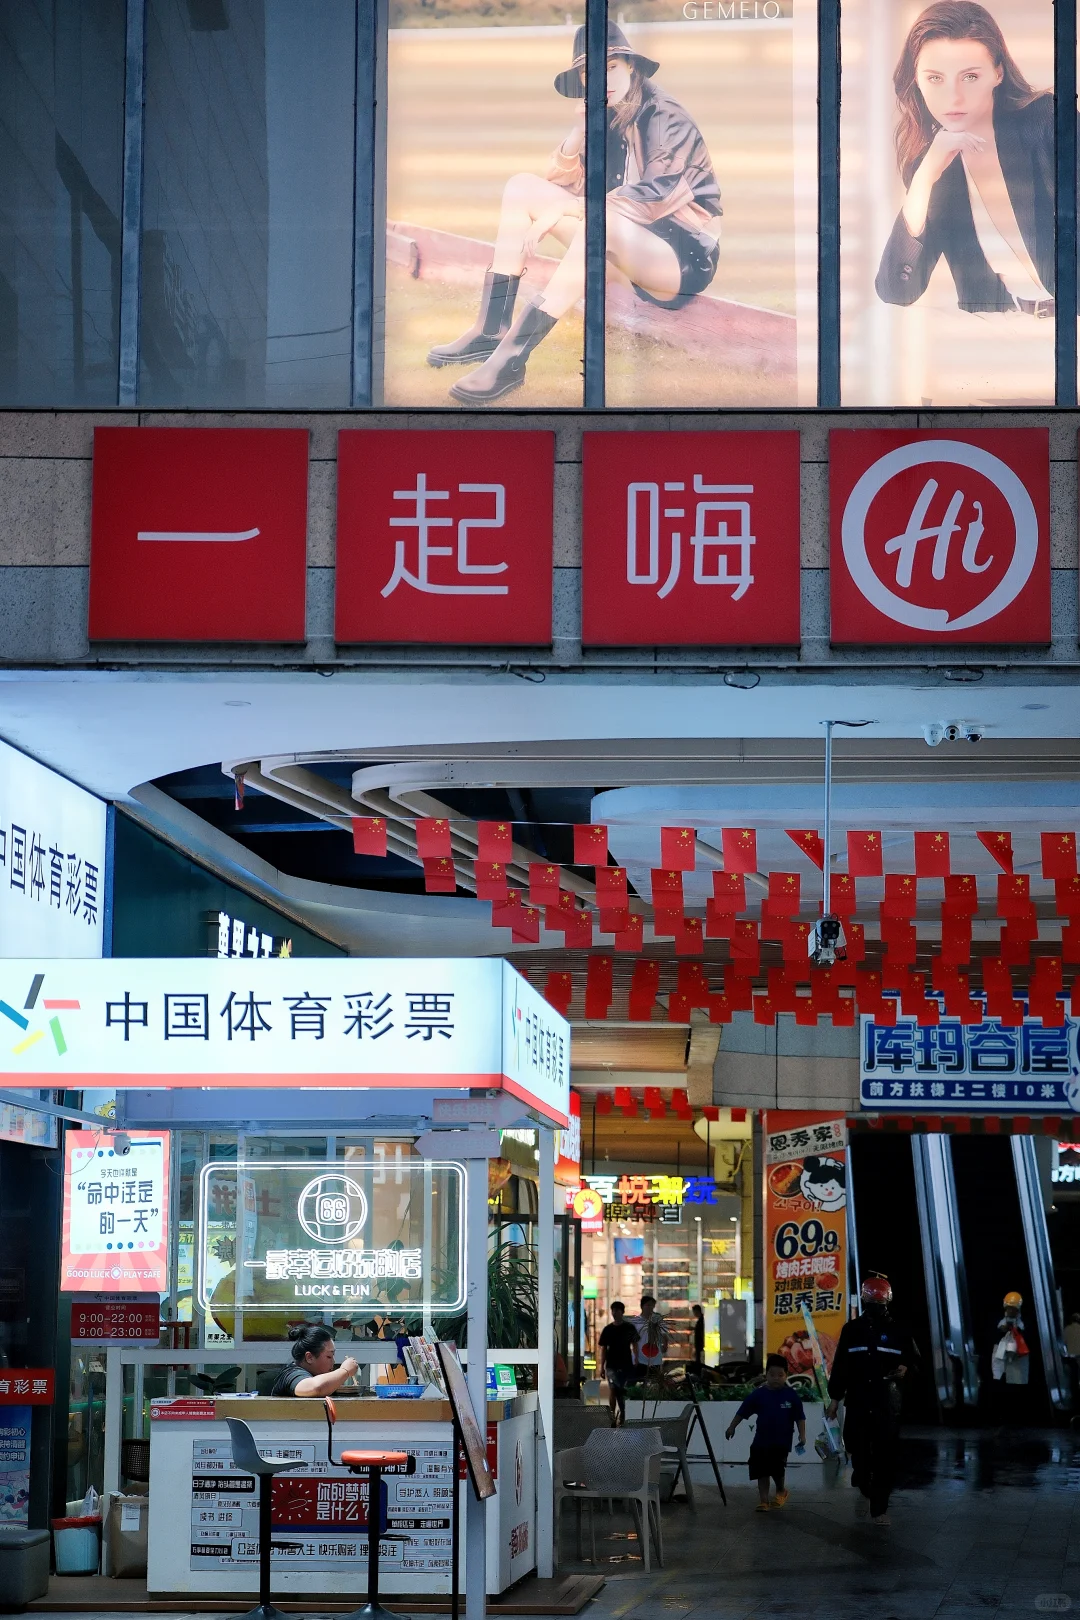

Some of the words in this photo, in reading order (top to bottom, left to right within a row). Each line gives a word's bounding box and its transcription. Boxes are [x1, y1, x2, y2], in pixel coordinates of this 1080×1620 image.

[682, 0, 780, 20] GEMEIO
[136, 472, 757, 602] 一起嗨
[884, 476, 995, 590] Hi
[104, 990, 456, 1042] 中国体育彩票
[525, 1006, 564, 1089] 中国体育彩票
[864, 1019, 1073, 1075] 库玛谷屋
[869, 1081, 1056, 1098] 前方扶梯上二楼10米
[769, 1125, 833, 1152] 恩秀家
[100, 1167, 138, 1179] 今天也许就是
[774, 1218, 839, 1260] 69.9
[66, 1269, 89, 1278] GOOD
[90, 1270, 110, 1278] LUCK
[123, 1270, 142, 1279] PLAY
[143, 1269, 161, 1278] SAFE
[775, 1255, 837, 1279] 烤肉无限吃
[294, 1284, 332, 1296] LUCK
[332, 1284, 341, 1296] &
[342, 1284, 370, 1296] FUN
[359, 1543, 398, 1557] 理投注
